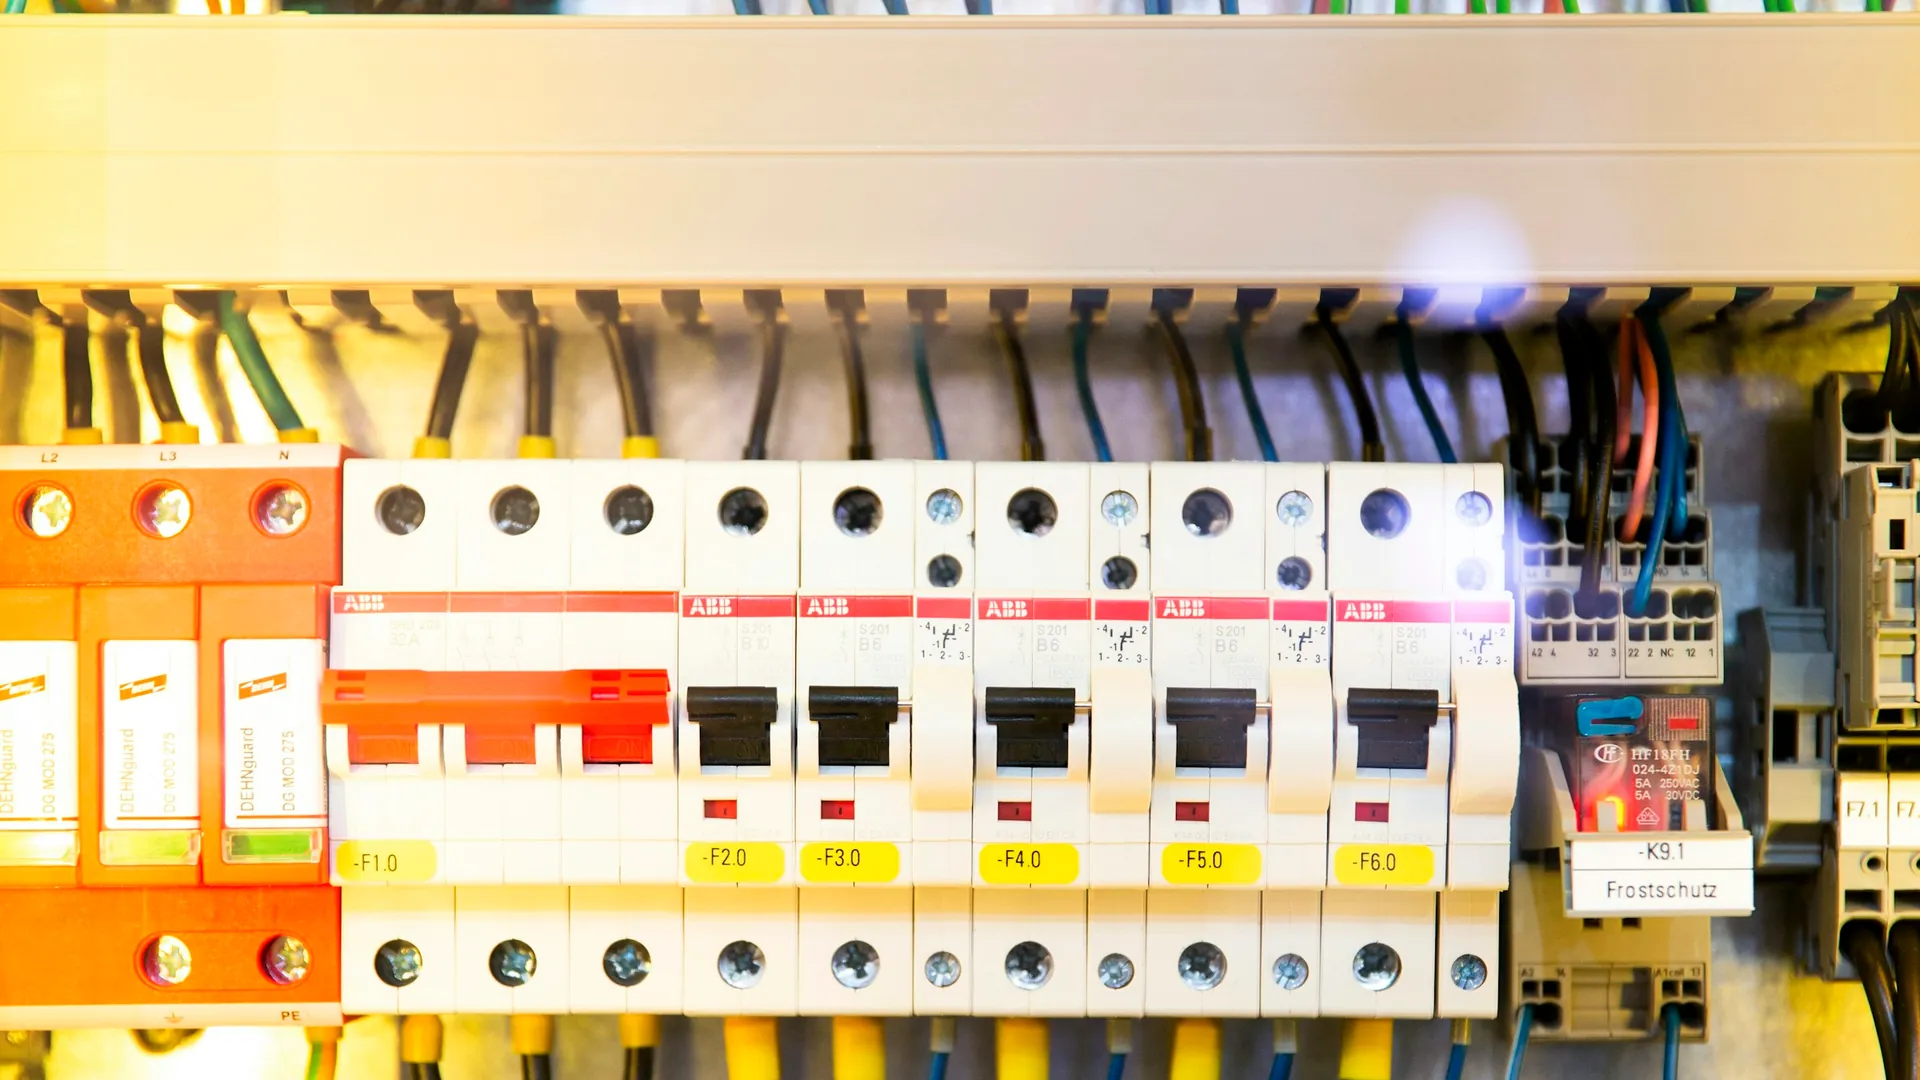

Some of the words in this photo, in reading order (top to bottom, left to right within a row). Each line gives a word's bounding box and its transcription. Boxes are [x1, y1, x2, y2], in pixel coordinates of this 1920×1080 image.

[41, 453, 59, 463] L2
[160, 451, 178, 462] L3
[279, 451, 290, 461] N
[343, 594, 385, 611] ABB
[689, 597, 732, 615] ABB
[807, 597, 849, 615] ABB
[986, 601, 1028, 617] ABB
[1163, 599, 1205, 617] ABB
[1344, 602, 1386, 620] ABB
[1531, 648, 1543, 657] 42
[1550, 648, 1556, 657] 4
[1588, 648, 1599, 657] 32
[1610, 648, 1617, 657] 3
[1628, 648, 1639, 657] 22
[1647, 648, 1654, 657] 2
[1660, 648, 1674, 657] NC
[1685, 648, 1696, 657] 12
[1708, 648, 1714, 657] 1
[282, 730, 295, 753] 275
[1631, 749, 1691, 761] HF18FH
[240, 727, 257, 811] DEHNguard
[282, 757, 295, 788] MOD
[1635, 778, 1652, 788] 5A
[1659, 778, 1700, 788] 250VAC
[282, 792, 295, 811] DG
[1635, 790, 1651, 800] 5A
[1665, 790, 1700, 800] 30VDC
[1847, 800, 1879, 817] F7.1
[702, 848, 747, 867] -F2.0
[816, 848, 861, 867] -F3.0
[997, 850, 1041, 868] -F4.0
[1178, 850, 1222, 869] -F5.0
[1638, 842, 1685, 860] -K9.1
[353, 854, 397, 872] -F1.0
[1352, 852, 1396, 871] -F6.0
[1607, 881, 1718, 898] Frostschutz
[281, 1010, 301, 1021] PE
